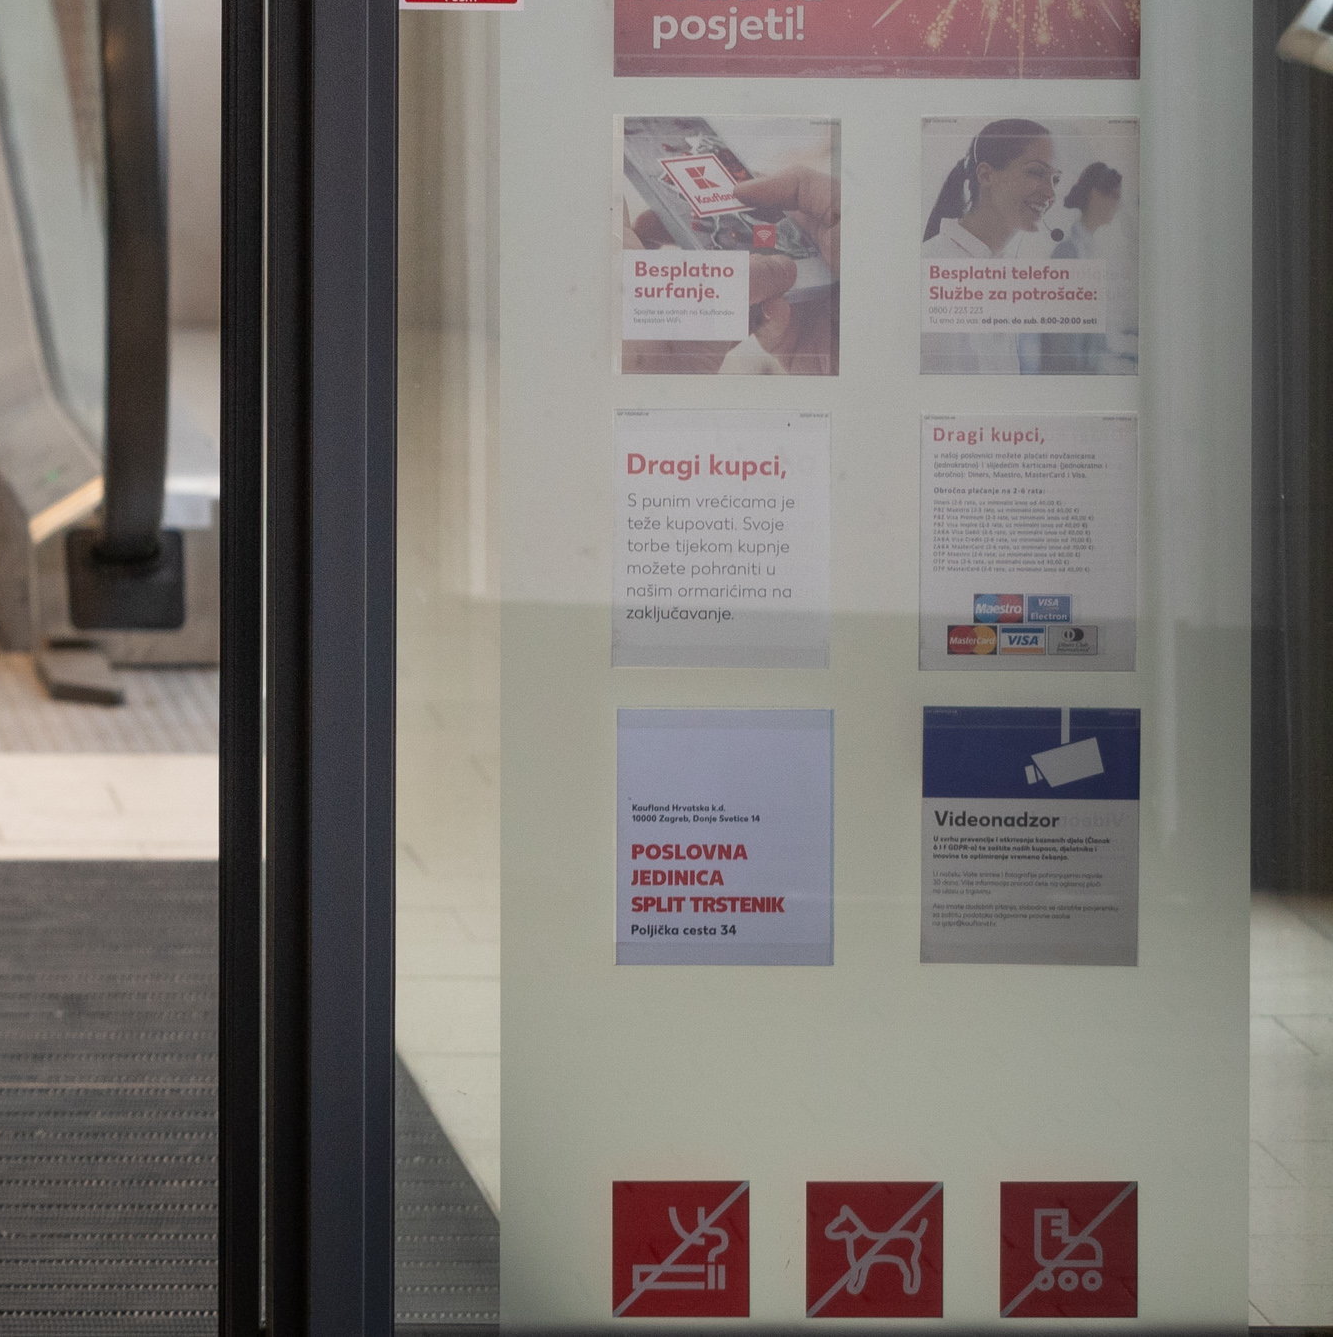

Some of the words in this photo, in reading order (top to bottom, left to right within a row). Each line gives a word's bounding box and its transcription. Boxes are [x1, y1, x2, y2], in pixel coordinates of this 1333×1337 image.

[652, 6, 805, 50] posjeti!
[634, 261, 735, 281] Besplatno
[929, 265, 1007, 284] Besplatni
[1011, 265, 1070, 280] telefon
[633, 282, 720, 303] surfanje.
[929, 285, 984, 300] Službe
[988, 289, 1007, 301] za
[1012, 286, 1098, 304] potrošače:
[933, 426, 984, 445] Dragi
[990, 426, 1046, 444] kupci,
[627, 453, 700, 481] Dragi
[709, 454, 787, 481] kupci,
[627, 493, 637, 508] S
[642, 494, 691, 510] punim
[696, 494, 777, 509] vrećicama
[780, 495, 796, 512] je
[627, 517, 661, 530] teže
[666, 516, 737, 534] kupovati.
[743, 517, 785, 534] Svoje
[627, 538, 670, 553] torbe
[675, 539, 733, 556] tijekom
[738, 539, 790, 557] kupnje
[626, 561, 686, 575] možete
[690, 561, 762, 578] pohraniti
[766, 566, 776, 576] u
[626, 584, 673, 598] našim
[677, 584, 767, 598] ormarićima
[772, 588, 792, 598] na
[975, 603, 1023, 615] Maestro
[1037, 597, 1059, 608] VISA
[626, 606, 734, 623] zaključavanje.
[1030, 612, 1068, 621] Electron
[1007, 635, 1039, 646] VISA
[632, 804, 670, 812] Kaufland
[672, 804, 710, 812] Hrvatska
[632, 815, 657, 823] 10000
[659, 815, 691, 824] Zagreb,
[692, 815, 717, 824] Donje
[719, 815, 749, 823] Svetice
[751, 815, 761, 823] 14
[934, 810, 1060, 828] Videonadzor
[631, 843, 748, 860] POSLOVNA
[631, 870, 725, 886] JEDINICA
[631, 896, 685, 913] SPLIT
[690, 896, 786, 913] TRSTENIK
[631, 924, 680, 938] Poljička
[683, 925, 717, 936] cesta
[720, 925, 737, 936] 34
